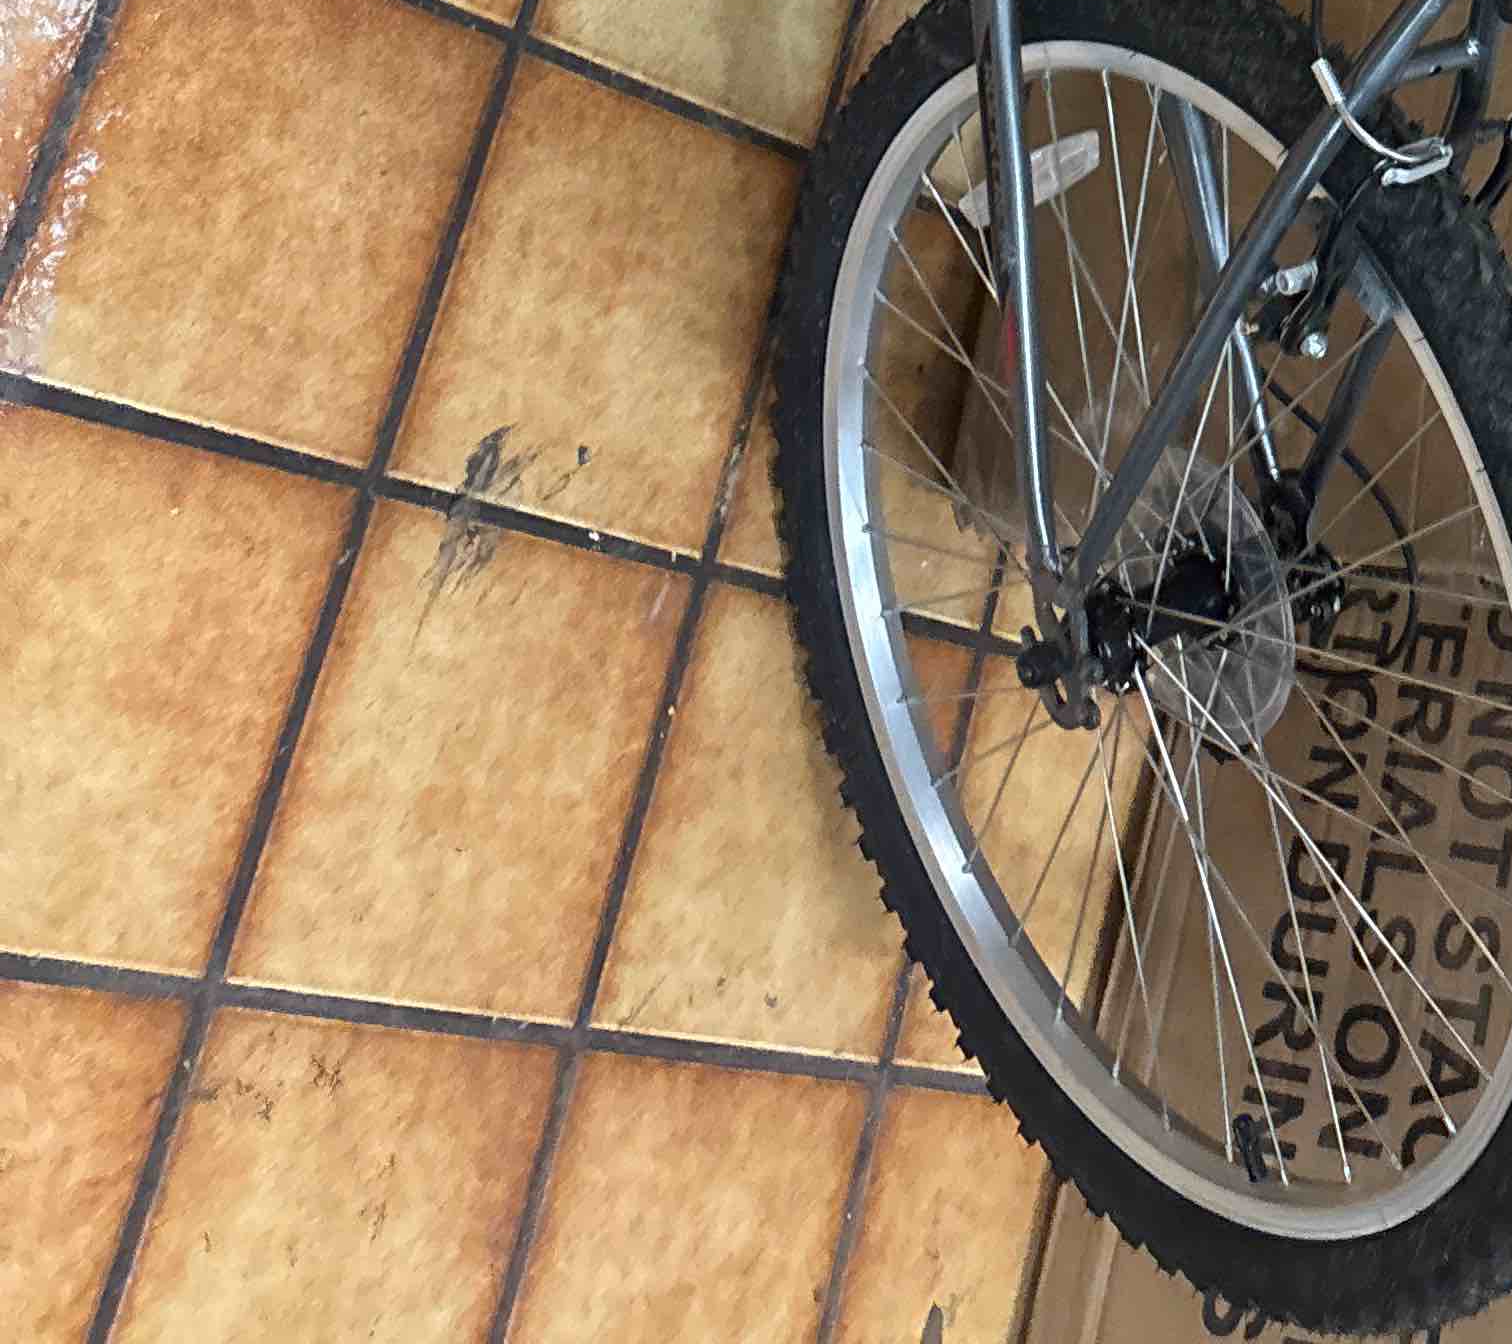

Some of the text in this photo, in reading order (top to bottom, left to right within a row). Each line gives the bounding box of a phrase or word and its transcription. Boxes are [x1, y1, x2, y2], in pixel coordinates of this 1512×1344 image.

[1240, 568, 1397, 1164] RTON DURIN
[1317, 606, 1466, 1160] ERIALS ON
[1400, 910, 1502, 1165] STAC
